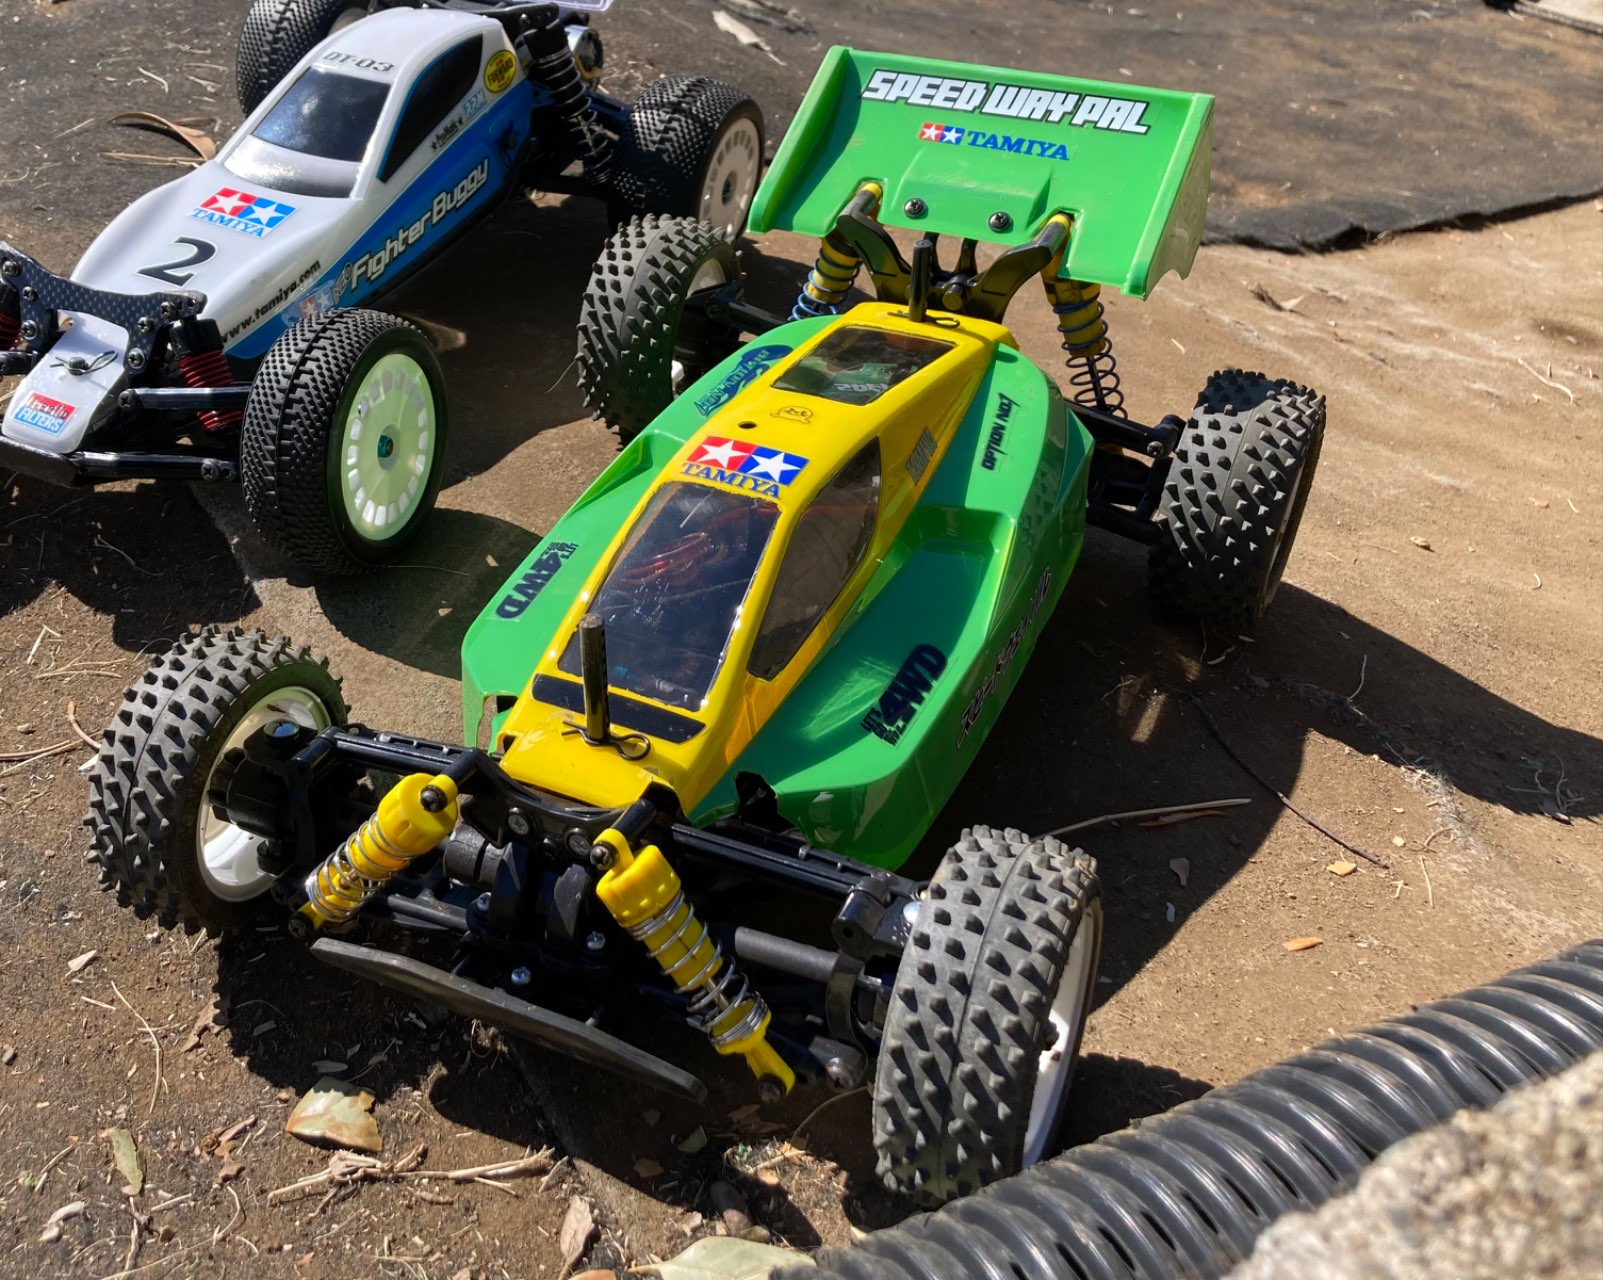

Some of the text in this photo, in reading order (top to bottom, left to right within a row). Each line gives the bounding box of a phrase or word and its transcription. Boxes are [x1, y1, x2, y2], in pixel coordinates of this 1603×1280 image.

[323, 51, 394, 72] DT-03
[861, 69, 1151, 135] SPEED WAY PAL
[967, 130, 1070, 161] TAMIYA
[190, 207, 265, 237] TAMIYA
[137, 236, 217, 287] 2
[18, 407, 63, 432] FILTERS
[981, 421, 1008, 471] OPTION
[680, 462, 781, 499] TAMIYA
[496, 551, 562, 619] 4WD
[878, 643, 948, 727] 4WD
